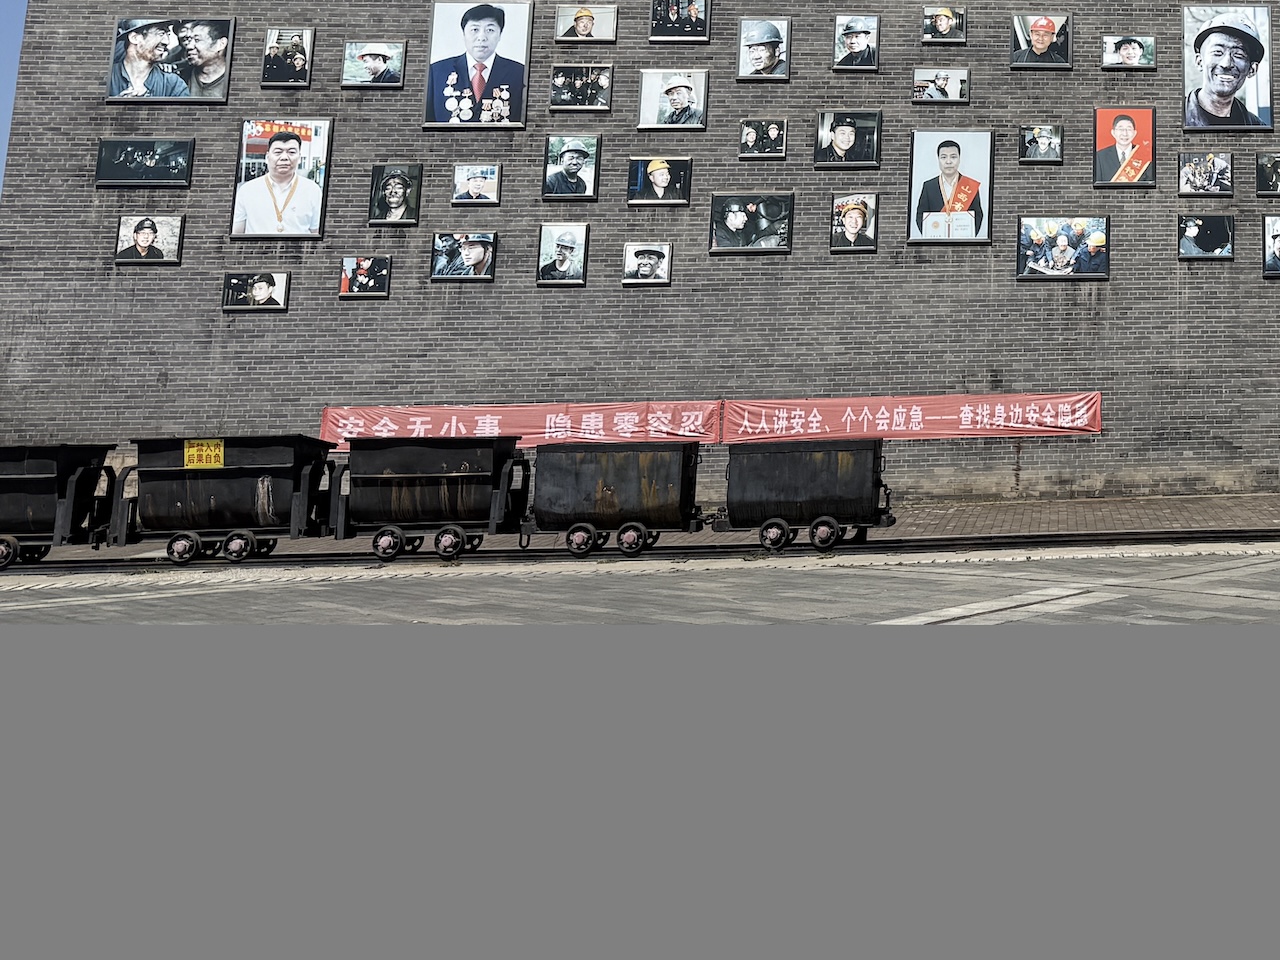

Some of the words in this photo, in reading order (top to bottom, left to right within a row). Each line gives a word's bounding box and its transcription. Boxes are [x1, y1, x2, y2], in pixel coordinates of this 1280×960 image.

[337, 414, 503, 442] 安全无小事
[545, 410, 705, 439] 隐患零容忍
[187, 441, 221, 453] 严禁入内
[187, 453, 221, 464] 后果自负
